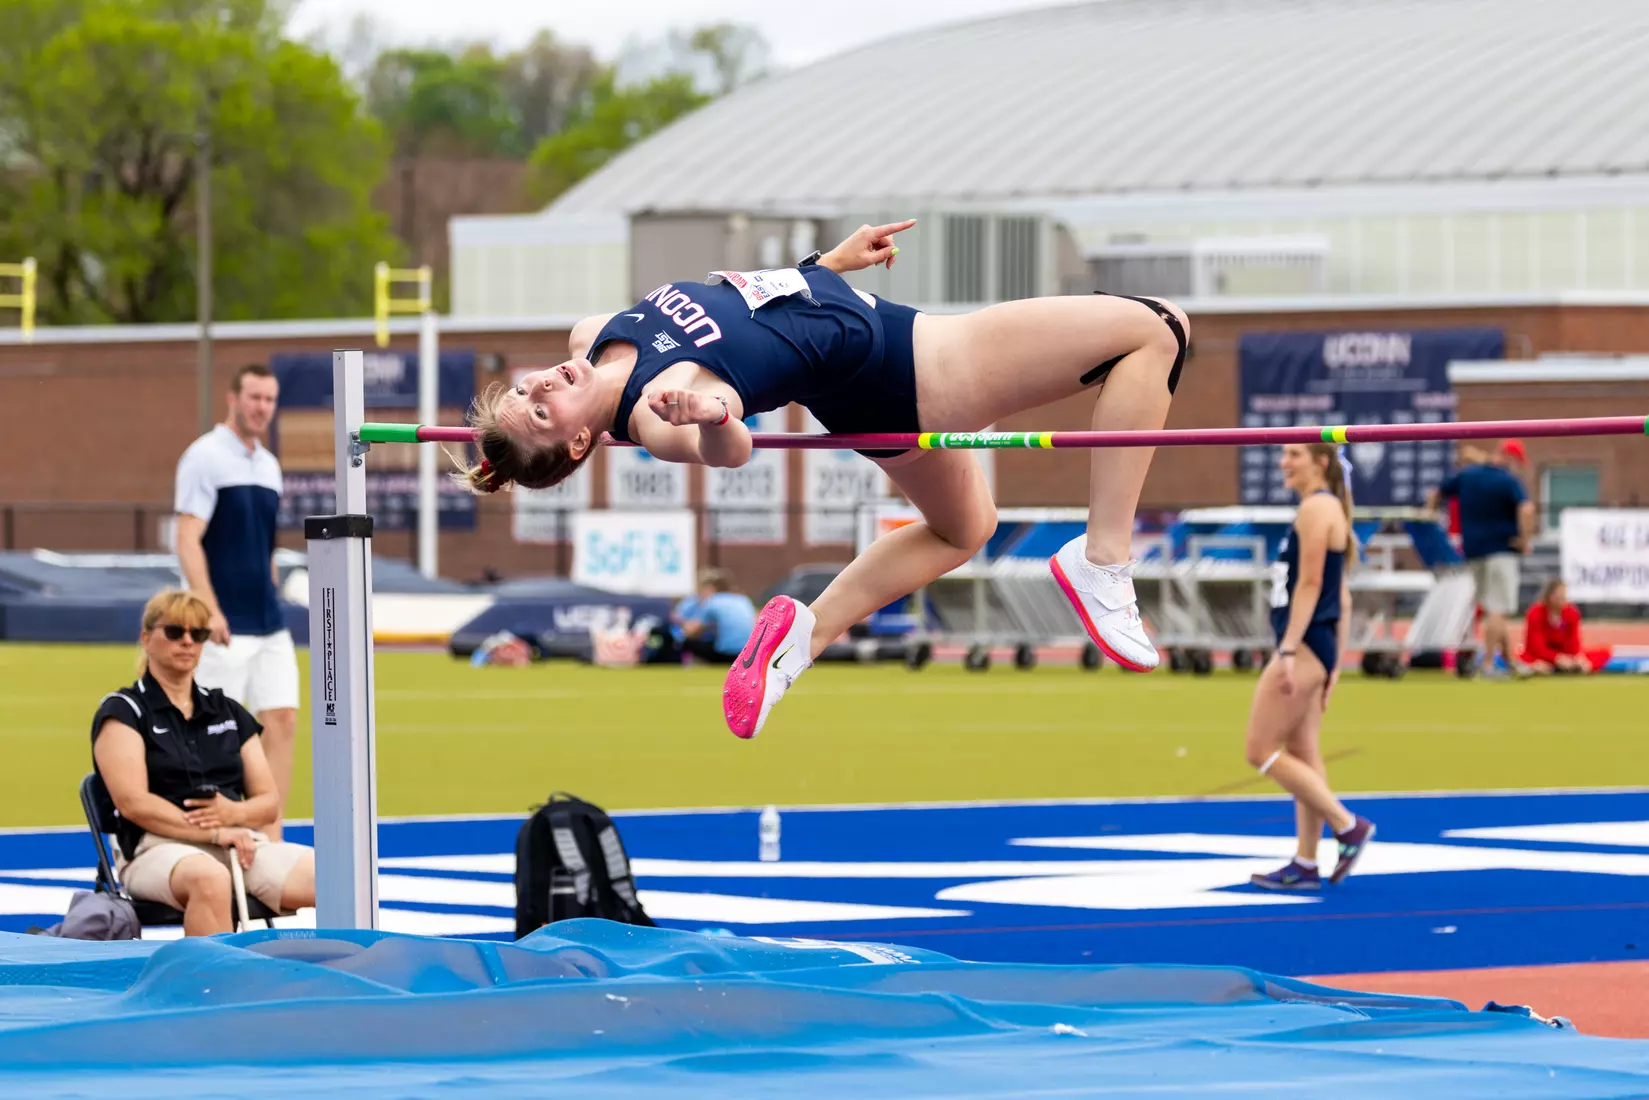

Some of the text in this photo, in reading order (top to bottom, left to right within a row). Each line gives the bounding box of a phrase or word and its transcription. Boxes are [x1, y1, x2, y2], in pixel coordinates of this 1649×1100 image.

[752, 290, 764, 301] BIG
[753, 285, 770, 298] EAST
[652, 340, 668, 354] BIG
[655, 333, 677, 350] EAST
